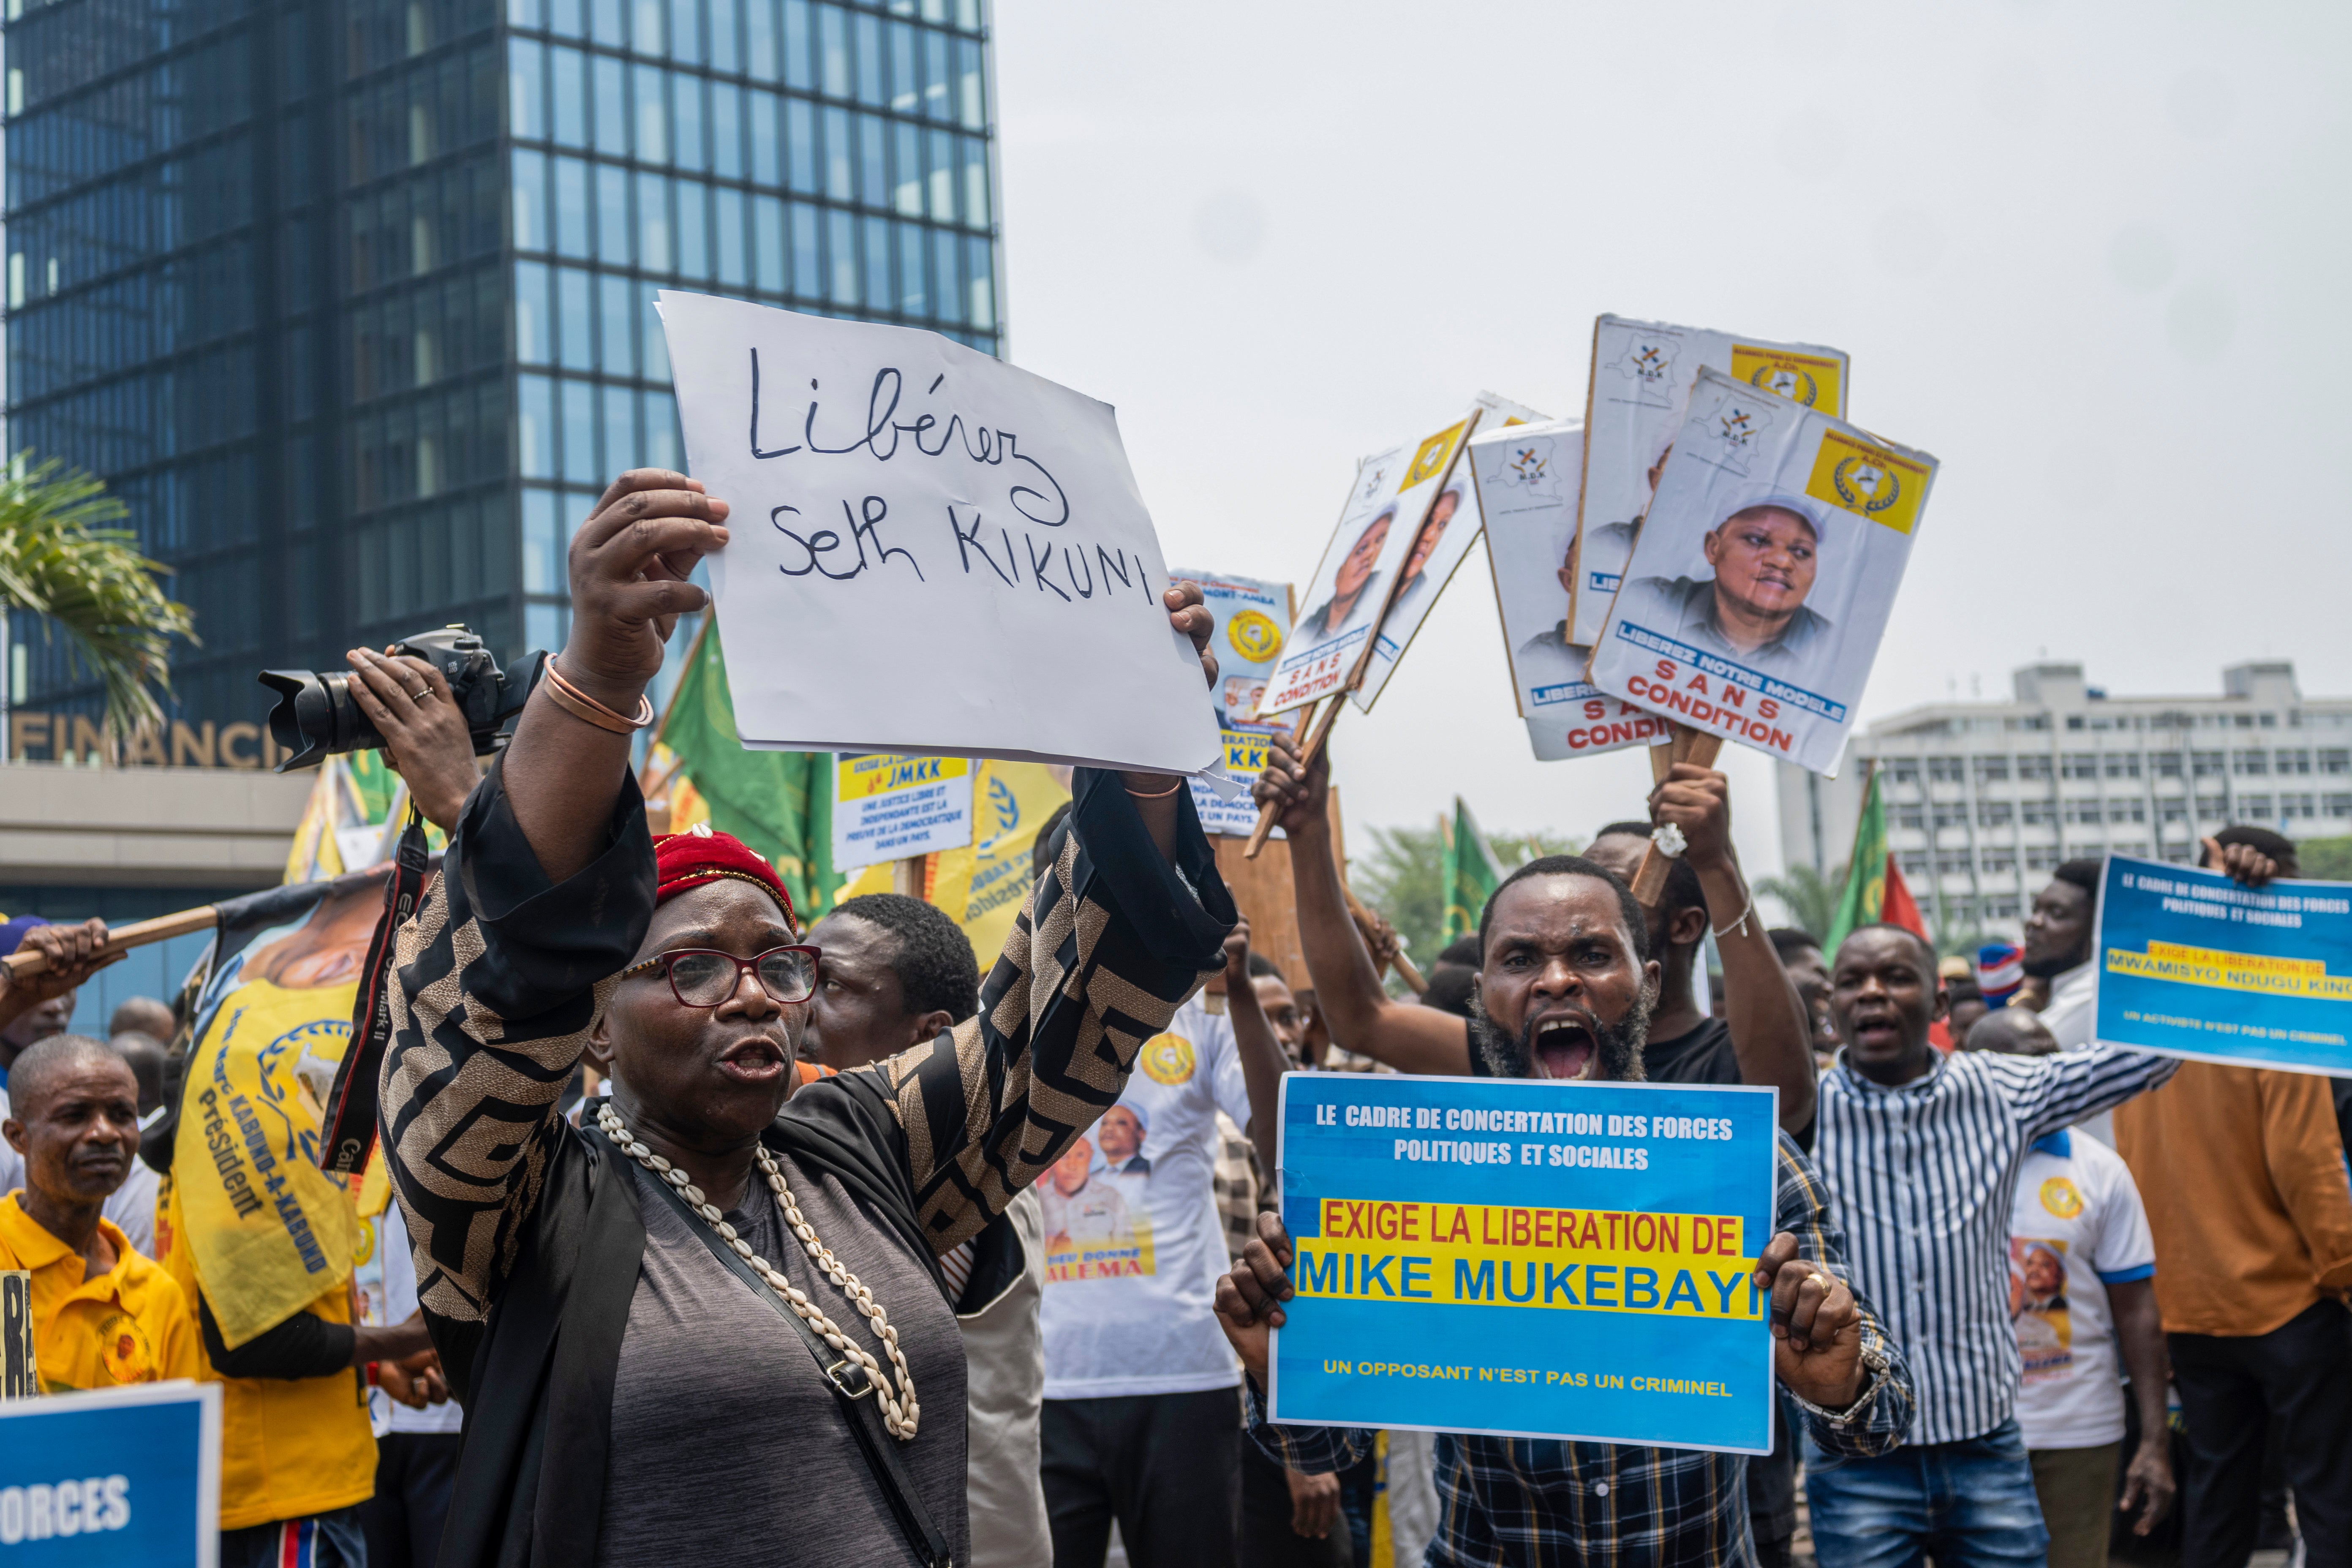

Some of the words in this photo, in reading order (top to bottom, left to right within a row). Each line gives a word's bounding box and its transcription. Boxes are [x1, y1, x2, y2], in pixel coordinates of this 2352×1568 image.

[751, 347, 1069, 527] Libérez
[1519, 471, 1546, 481] M.D.K
[771, 495, 925, 582] Seth
[947, 505, 1154, 606] KIKUNI
[1274, 668, 1342, 707] CONDITION
[1617, 623, 1698, 664] LIBEREZ
[1699, 655, 1763, 687] NOTRE
[1764, 678, 1846, 720] MODELE
[1583, 700, 1642, 721] SA
[1627, 675, 1793, 751] CONDITION
[9, 710, 294, 769] FINANCI
[1568, 715, 1675, 750] CONDI
[887, 758, 942, 789] JMKK
[1229, 747, 1263, 768] KK
[860, 804, 920, 826] INDEPENDANTE
[921, 800, 935, 814] EST
[936, 799, 947, 811] LA
[879, 792, 910, 808] JUSTICE
[911, 787, 934, 802] LIBRE
[936, 785, 947, 797] ET
[1207, 812, 1223, 821] UN
[2121, 872, 2135, 889] LE
[2137, 874, 2174, 896] CADRE
[2175, 880, 2190, 898] DE
[2190, 883, 2276, 910] CONCERTATION
[2278, 895, 2302, 912] DES
[2302, 896, 2350, 915] FORCES
[2162, 896, 2227, 920] POLITIQUES
[2230, 906, 2244, 923] ET
[2245, 908, 2303, 929] SOCIALES
[2109, 953, 2220, 982] MWAMISYO
[2227, 970, 2301, 991] NDUGU
[2149, 944, 2187, 958] EXIGE
[2194, 950, 2211, 962] LA
[2216, 955, 2300, 974] LIBERATION
[2306, 964, 2323, 974] DE
[2123, 1010, 2141, 1021] UN
[2142, 1013, 2202, 1030] ACTIVISTE
[2240, 1024, 2267, 1039] PAS
[2268, 1027, 2287, 1041] UN
[2288, 1029, 2348, 1047] CRIMINEL
[1316, 1104, 1337, 1126] LE
[1345, 1105, 1411, 1128] CADRE
[1416, 1108, 1441, 1130] DE
[1446, 1108, 1603, 1136] CONCERTATION
[1608, 1114, 1648, 1138] DES
[1652, 1116, 1733, 1141] FORCES
[197, 1086, 265, 1221] Président
[1394, 1139, 1512, 1165] POLITIQUES
[1521, 1143, 1545, 1166] ET
[1549, 1144, 1649, 1171] SOCIALES
[1326, 1200, 1420, 1241] EXIGE
[1431, 1206, 1472, 1244] LA
[1483, 1208, 1680, 1254] LIBERATION
[1693, 1217, 1737, 1257] DE
[1298, 1251, 1433, 1298] MIKE
[1454, 1258, 1759, 1315] MUKEBAYI
[1323, 1359, 1352, 1375] UN
[1357, 1361, 1473, 1380] OPPOSANT
[1479, 1367, 1540, 1383] N'EST
[1546, 1370, 1588, 1387] PAS
[1594, 1374, 1624, 1389] UN
[1630, 1376, 1733, 1397] CRIMINEL
[0, 1473, 131, 1545] ORCES
